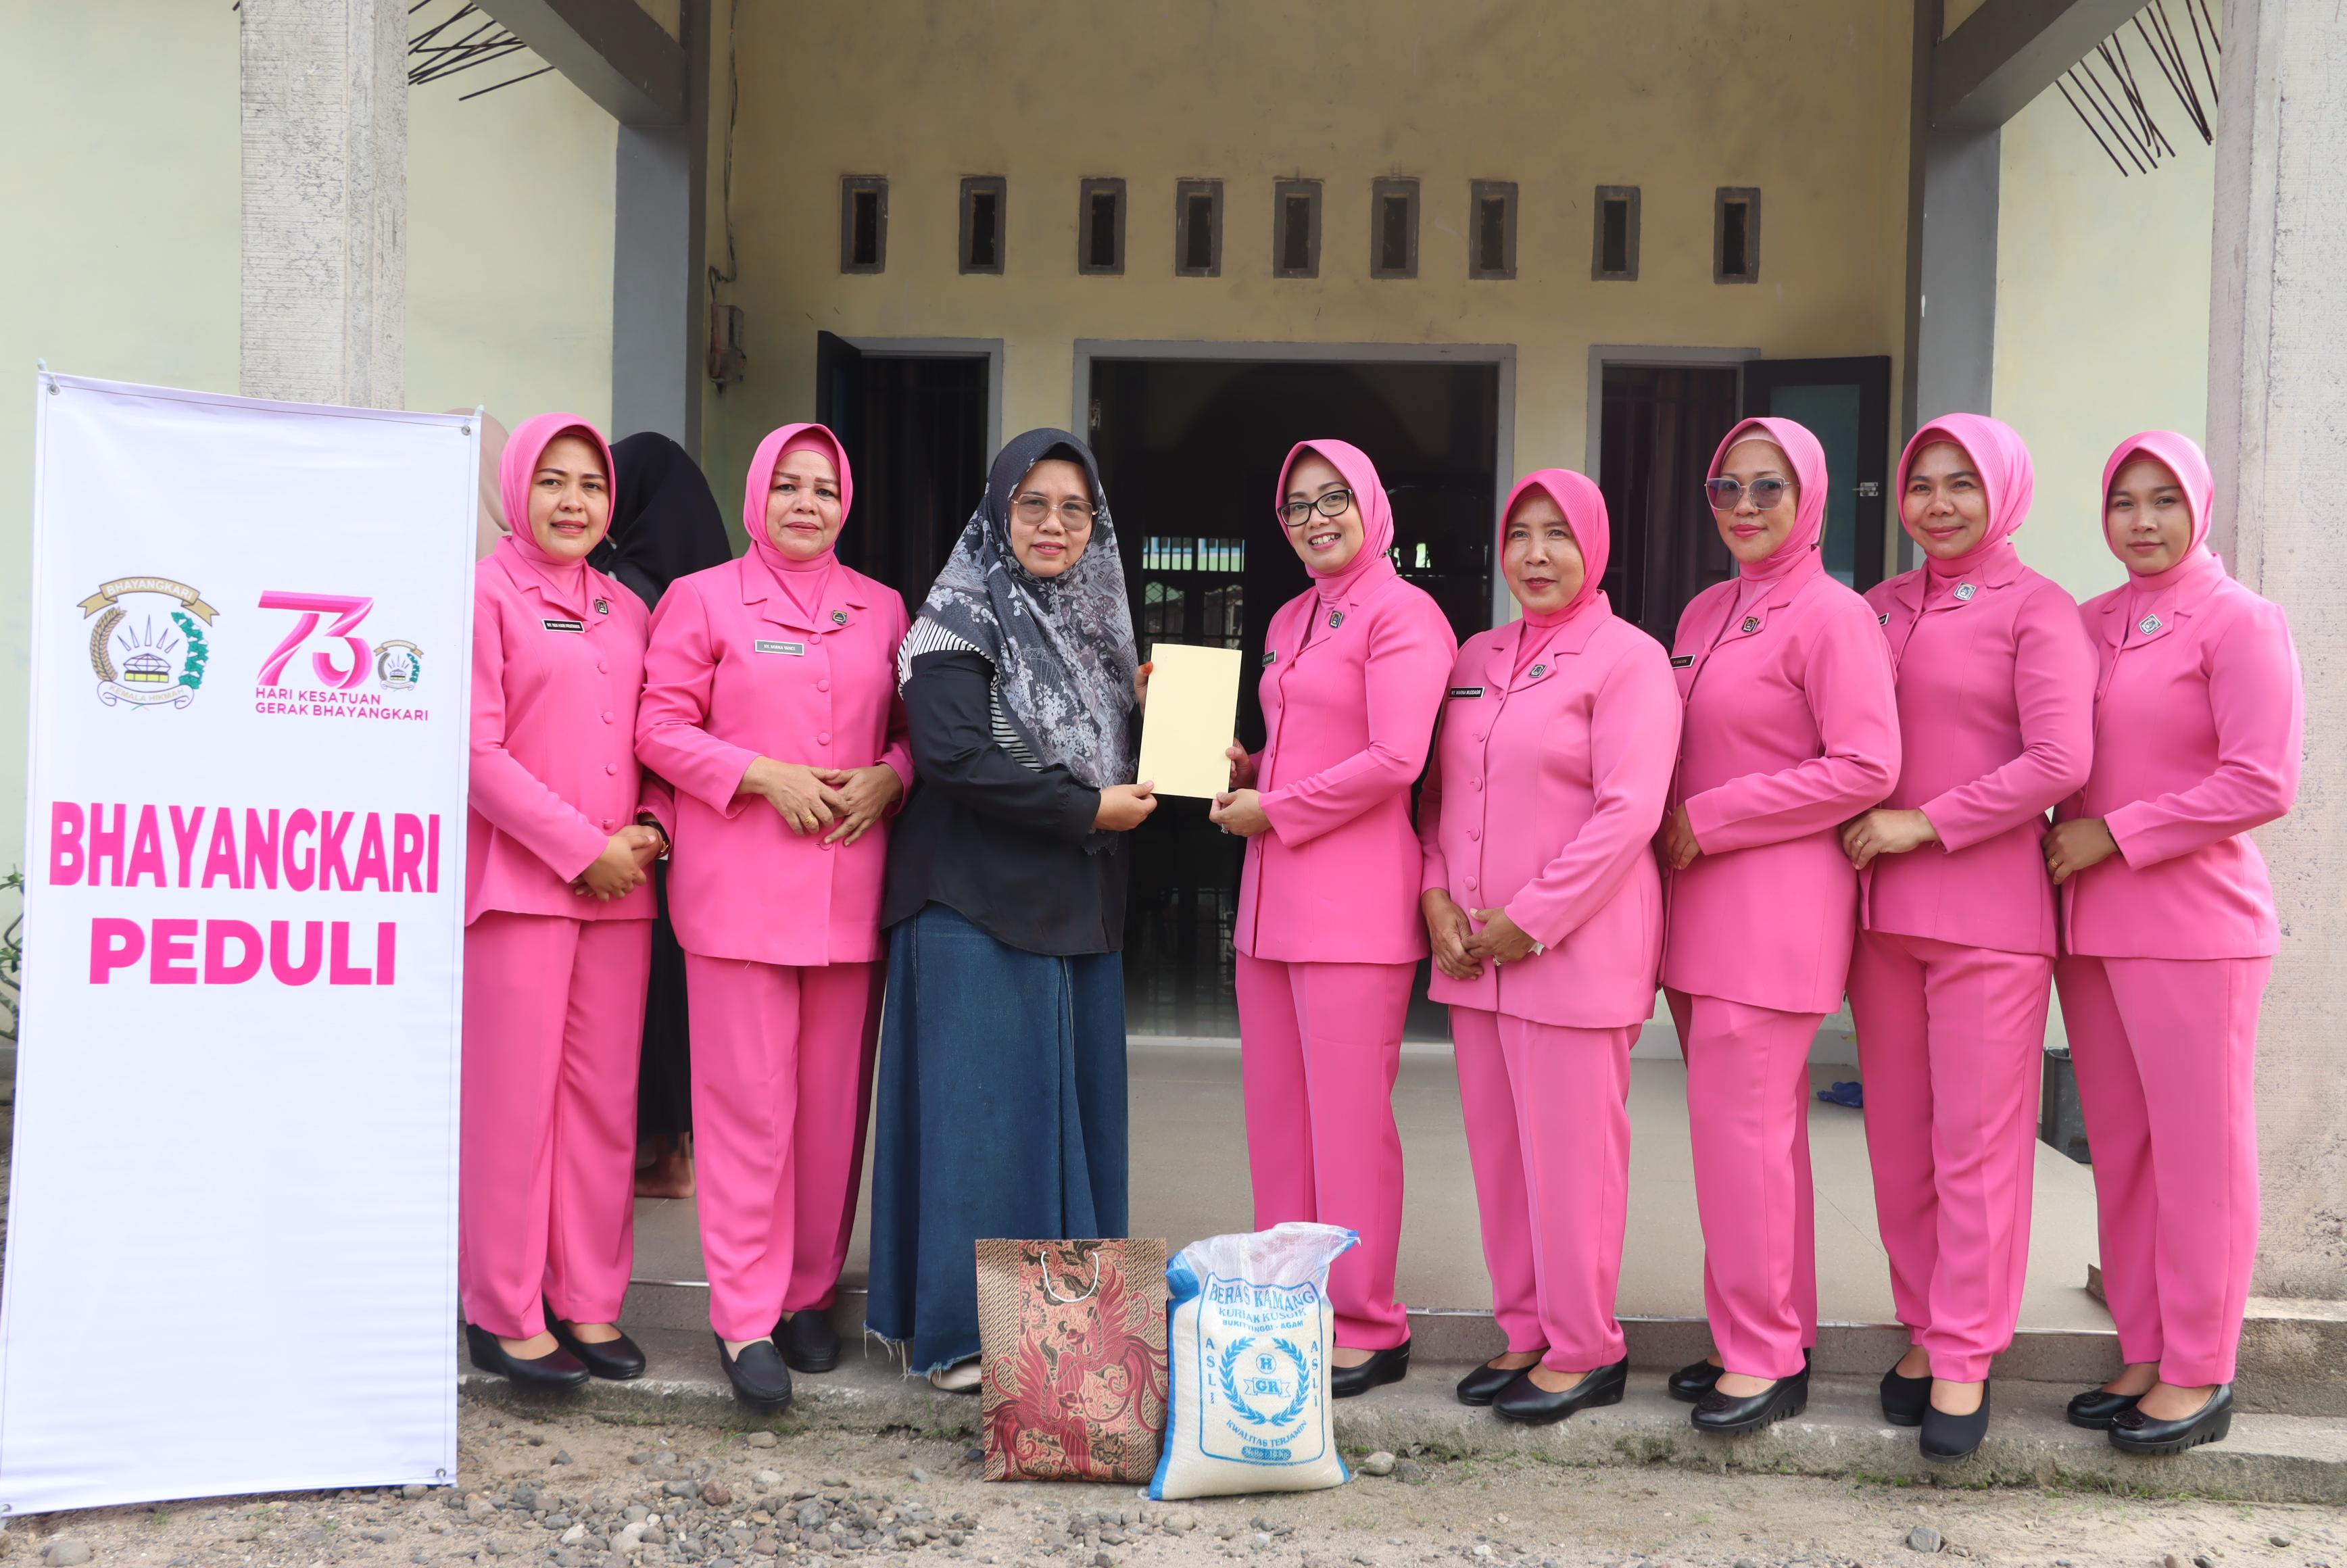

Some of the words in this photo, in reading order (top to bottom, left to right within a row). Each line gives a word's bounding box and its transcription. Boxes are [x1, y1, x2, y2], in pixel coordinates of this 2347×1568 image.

[106, 580, 193, 600] BHAYANGKARI
[256, 590, 374, 689] 73
[109, 685, 146, 702] KEMALA
[148, 688, 185, 702] HIKMAH
[256, 687, 293, 700] HARI
[298, 691, 381, 705] KESATUAN
[256, 702, 308, 715] GERAK
[313, 704, 429, 721] BHAYANGKARI
[49, 801, 441, 893] BHAYANGKARI
[89, 918, 397, 986] PEDULI
[1209, 1283, 1251, 1305] BERAS
[1254, 1290, 1315, 1311] KAMANG
[1222, 1319, 1274, 1333] BUKITTINGGI
[1280, 1320, 1303, 1329] AGAM
[1260, 1357, 1272, 1370] H
[1226, 1419, 1267, 1446] KWALITAS
[1270, 1420, 1307, 1446] TERJAMIN
